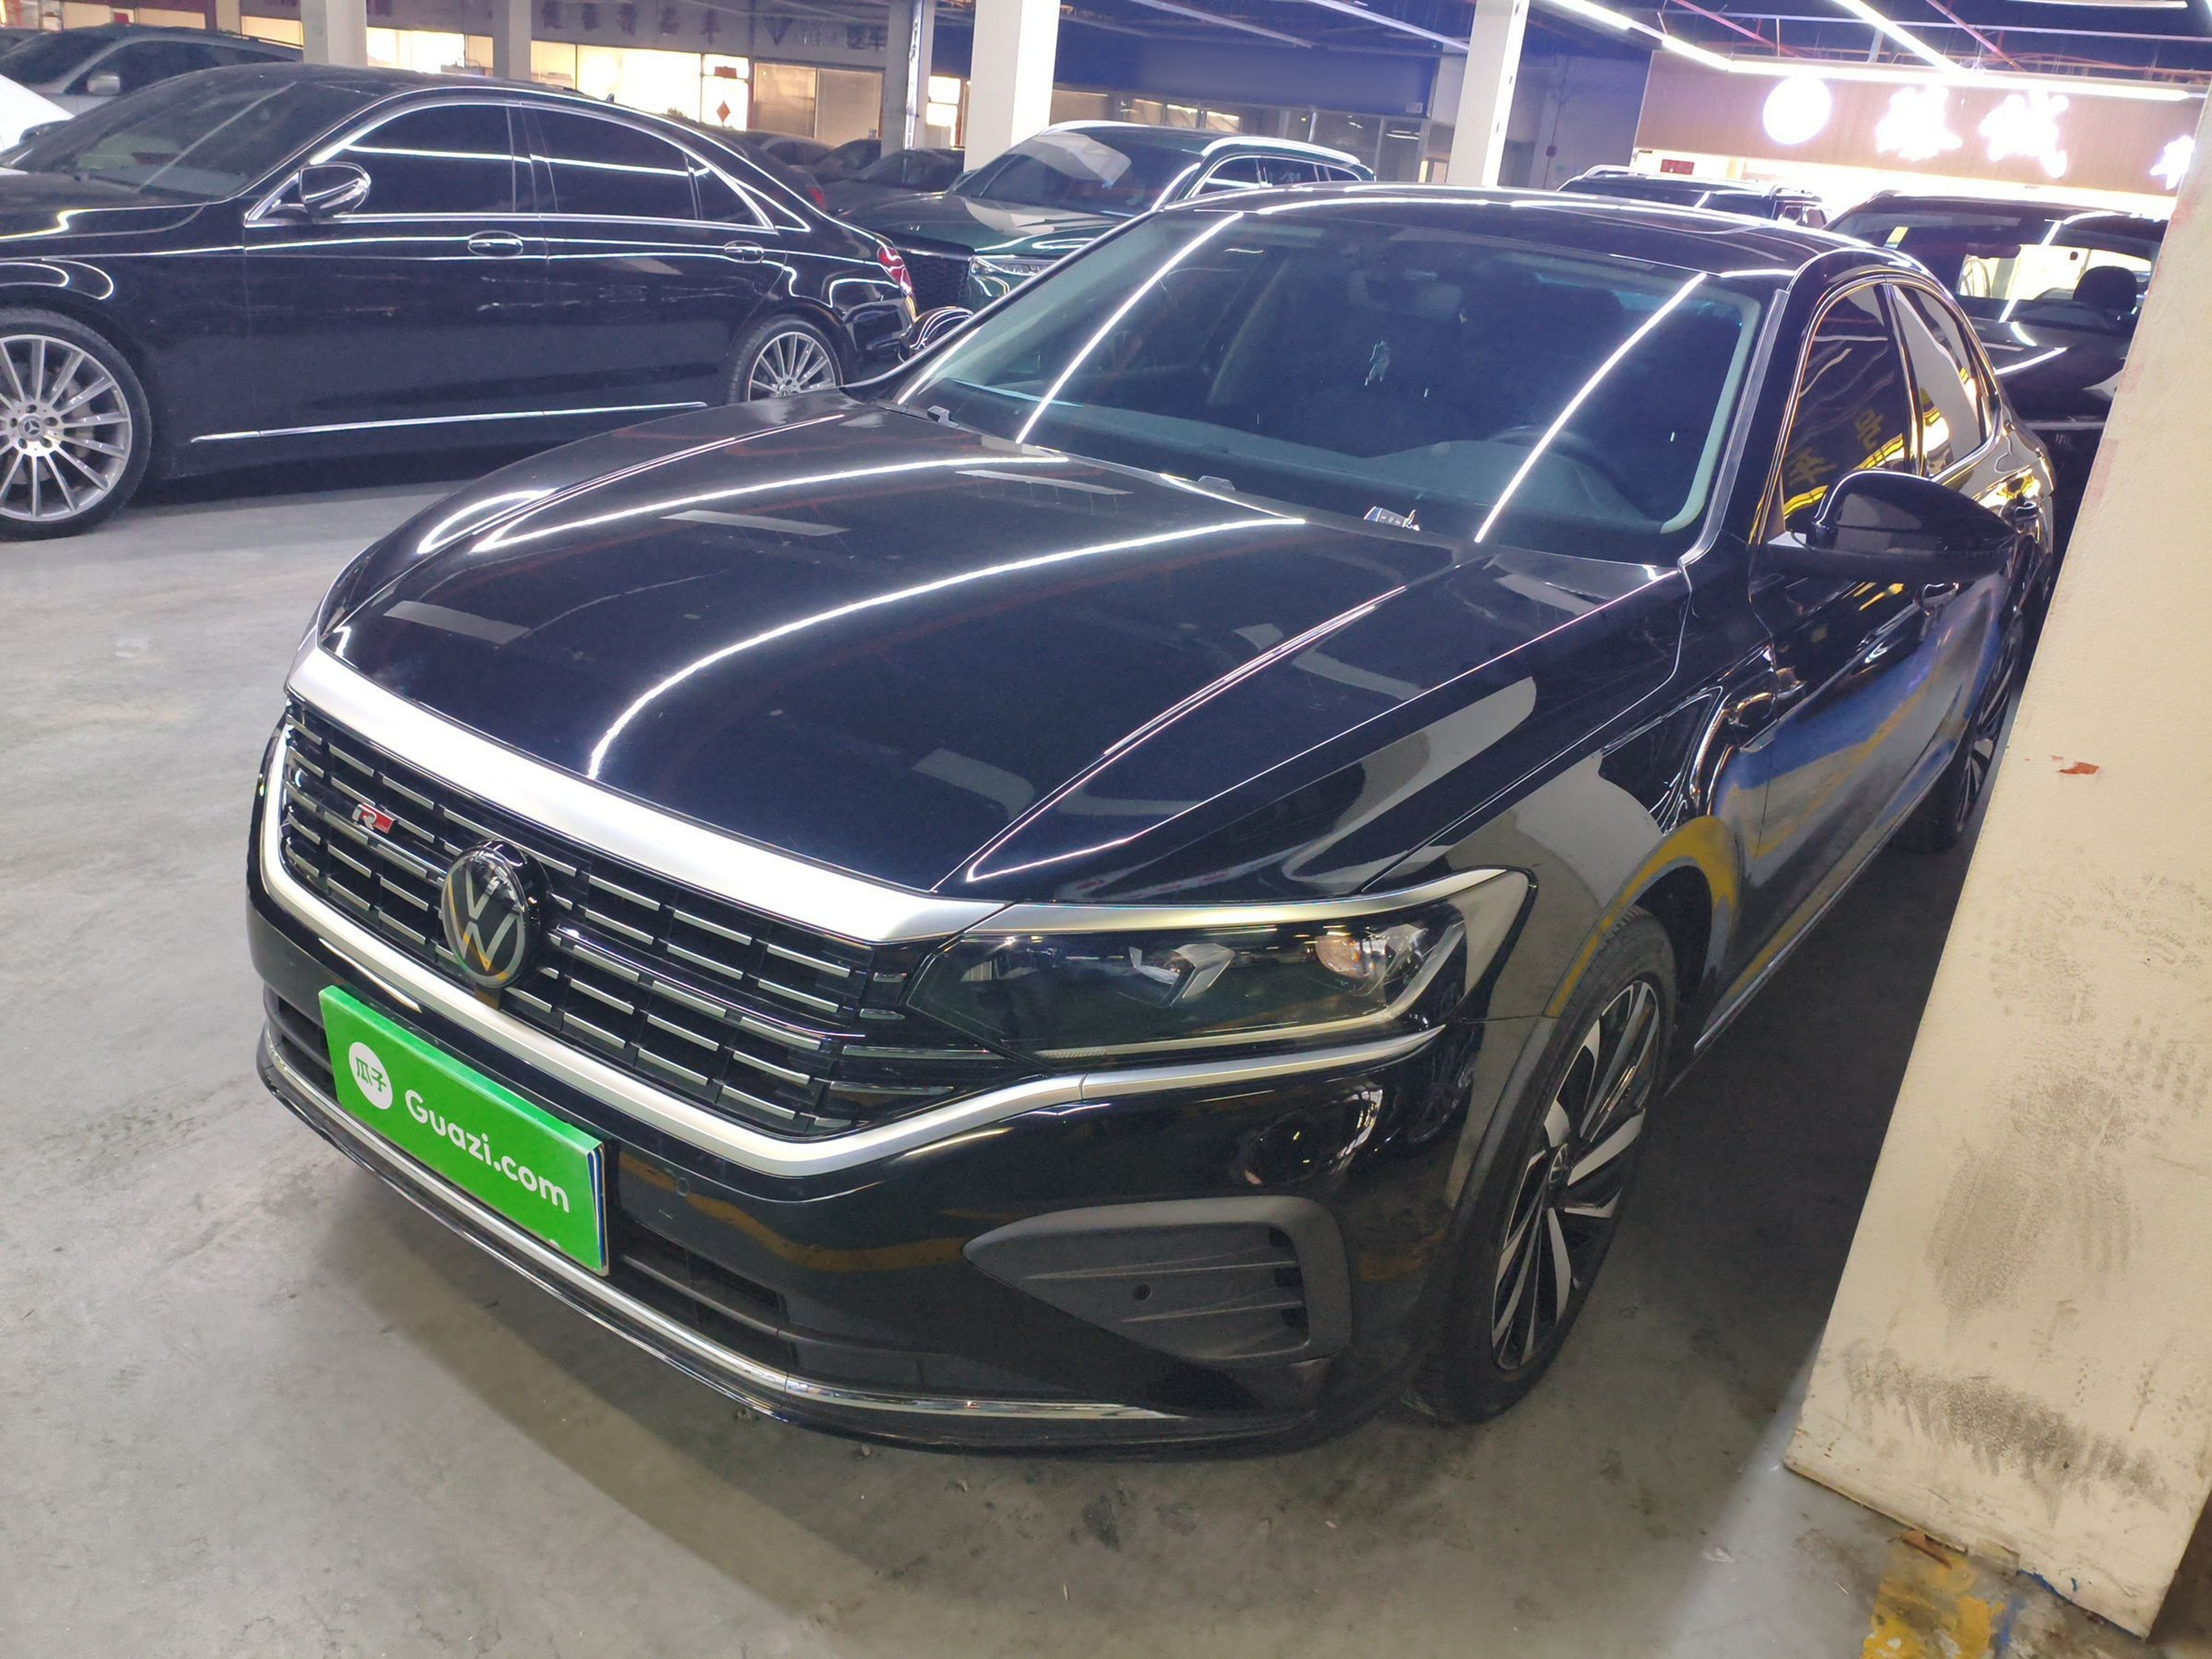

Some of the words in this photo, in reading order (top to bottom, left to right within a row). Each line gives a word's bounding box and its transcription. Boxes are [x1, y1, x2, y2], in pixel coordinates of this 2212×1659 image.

[352, 804, 377, 830] R
[355, 1056, 387, 1092] 瓜子
[405, 1089, 570, 1213] Guazi.com
